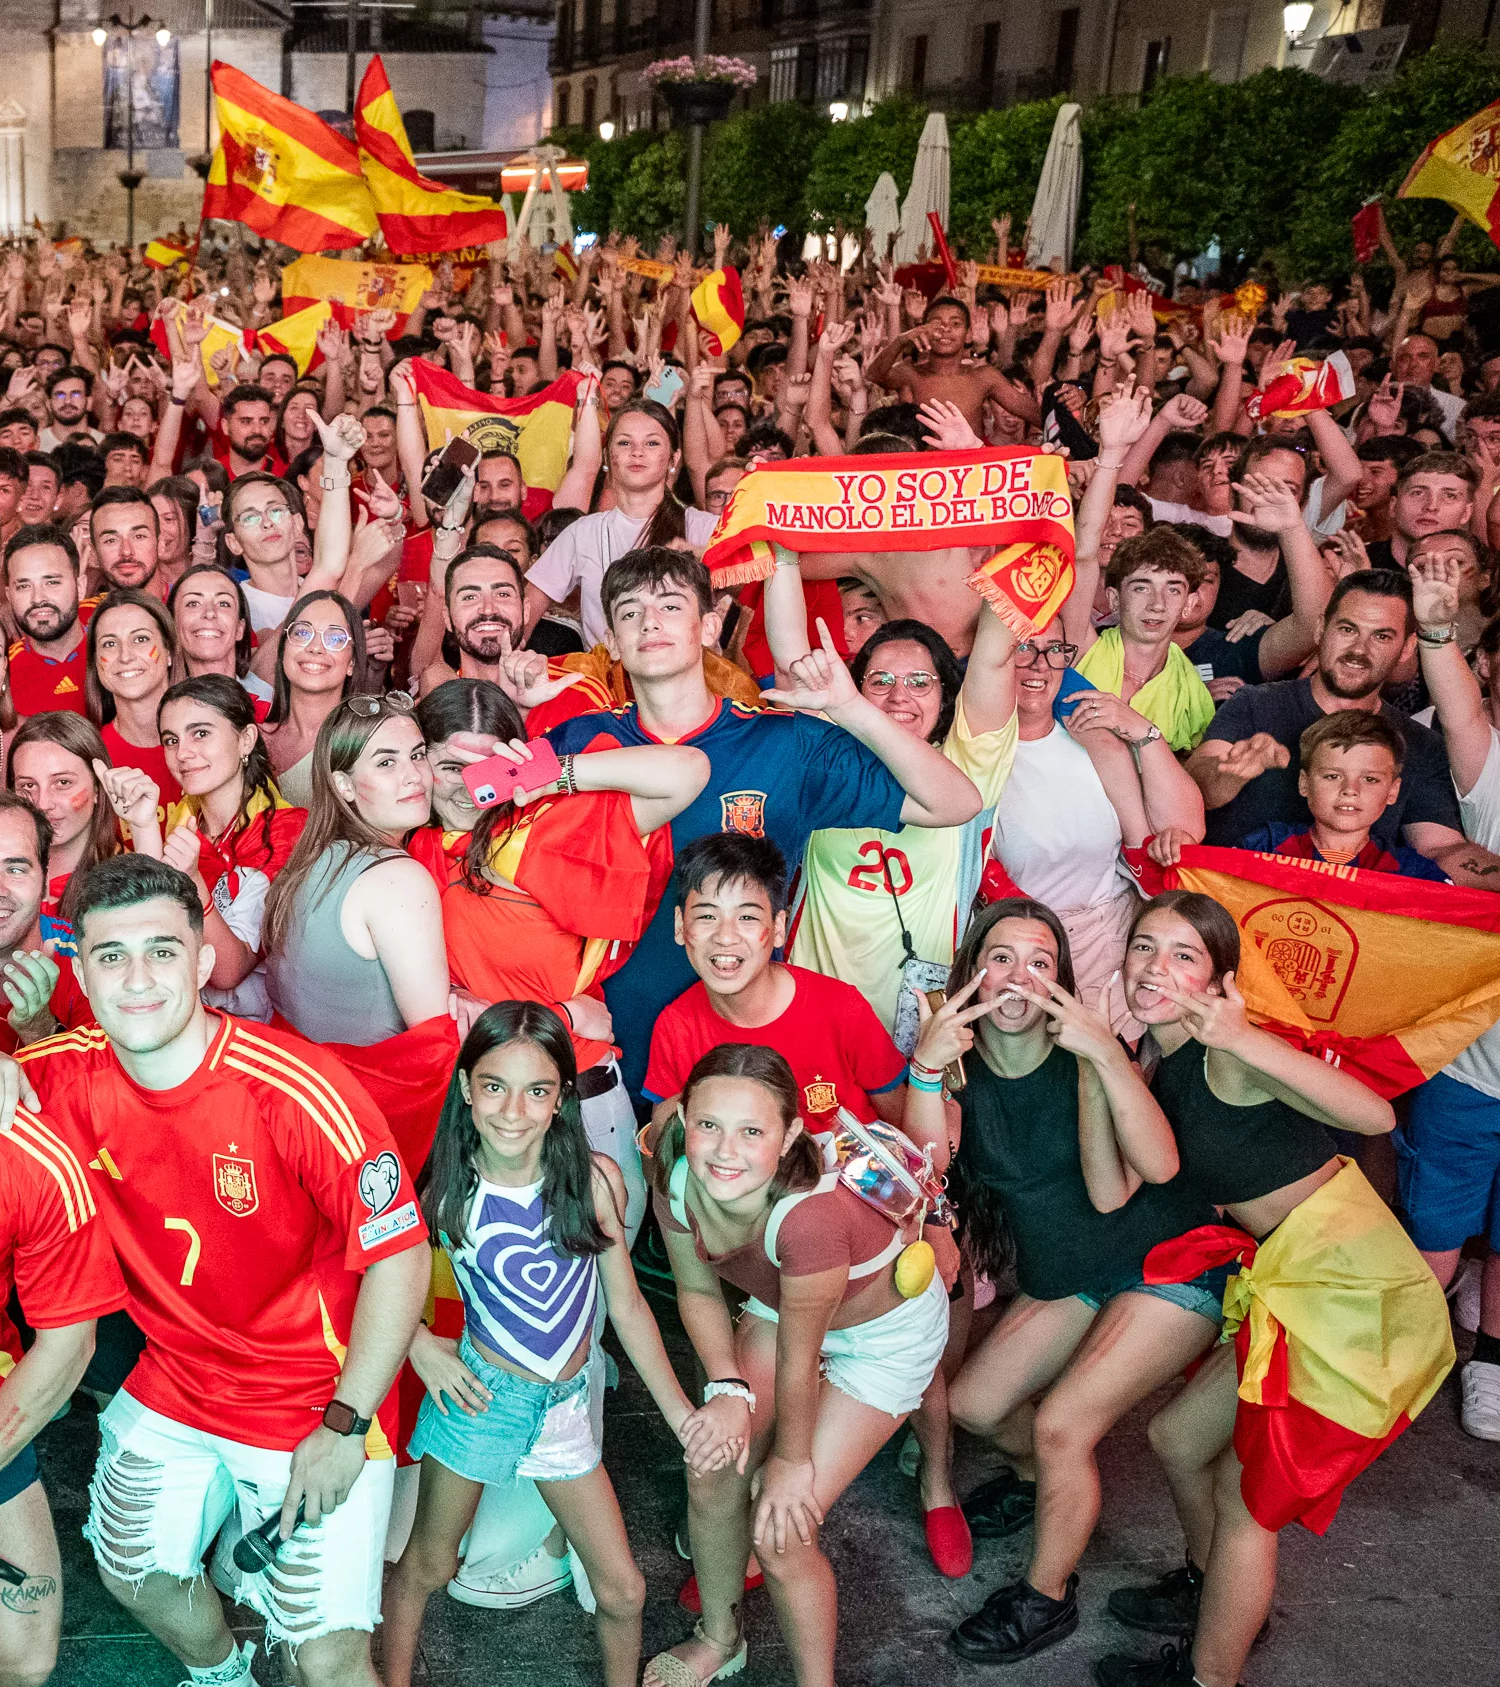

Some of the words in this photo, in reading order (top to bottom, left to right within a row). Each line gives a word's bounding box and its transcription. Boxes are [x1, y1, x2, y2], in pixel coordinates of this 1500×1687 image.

[835, 474, 887, 504] YO
[896, 468, 973, 503] SOY
[979, 459, 1033, 496] DE
[766, 503, 884, 530] MANOLO
[890, 503, 924, 528] EL
[930, 499, 984, 526] DEL
[847, 840, 914, 897] 20
[164, 1217, 202, 1287] 7
[0, 1579, 55, 1603] KARMA
